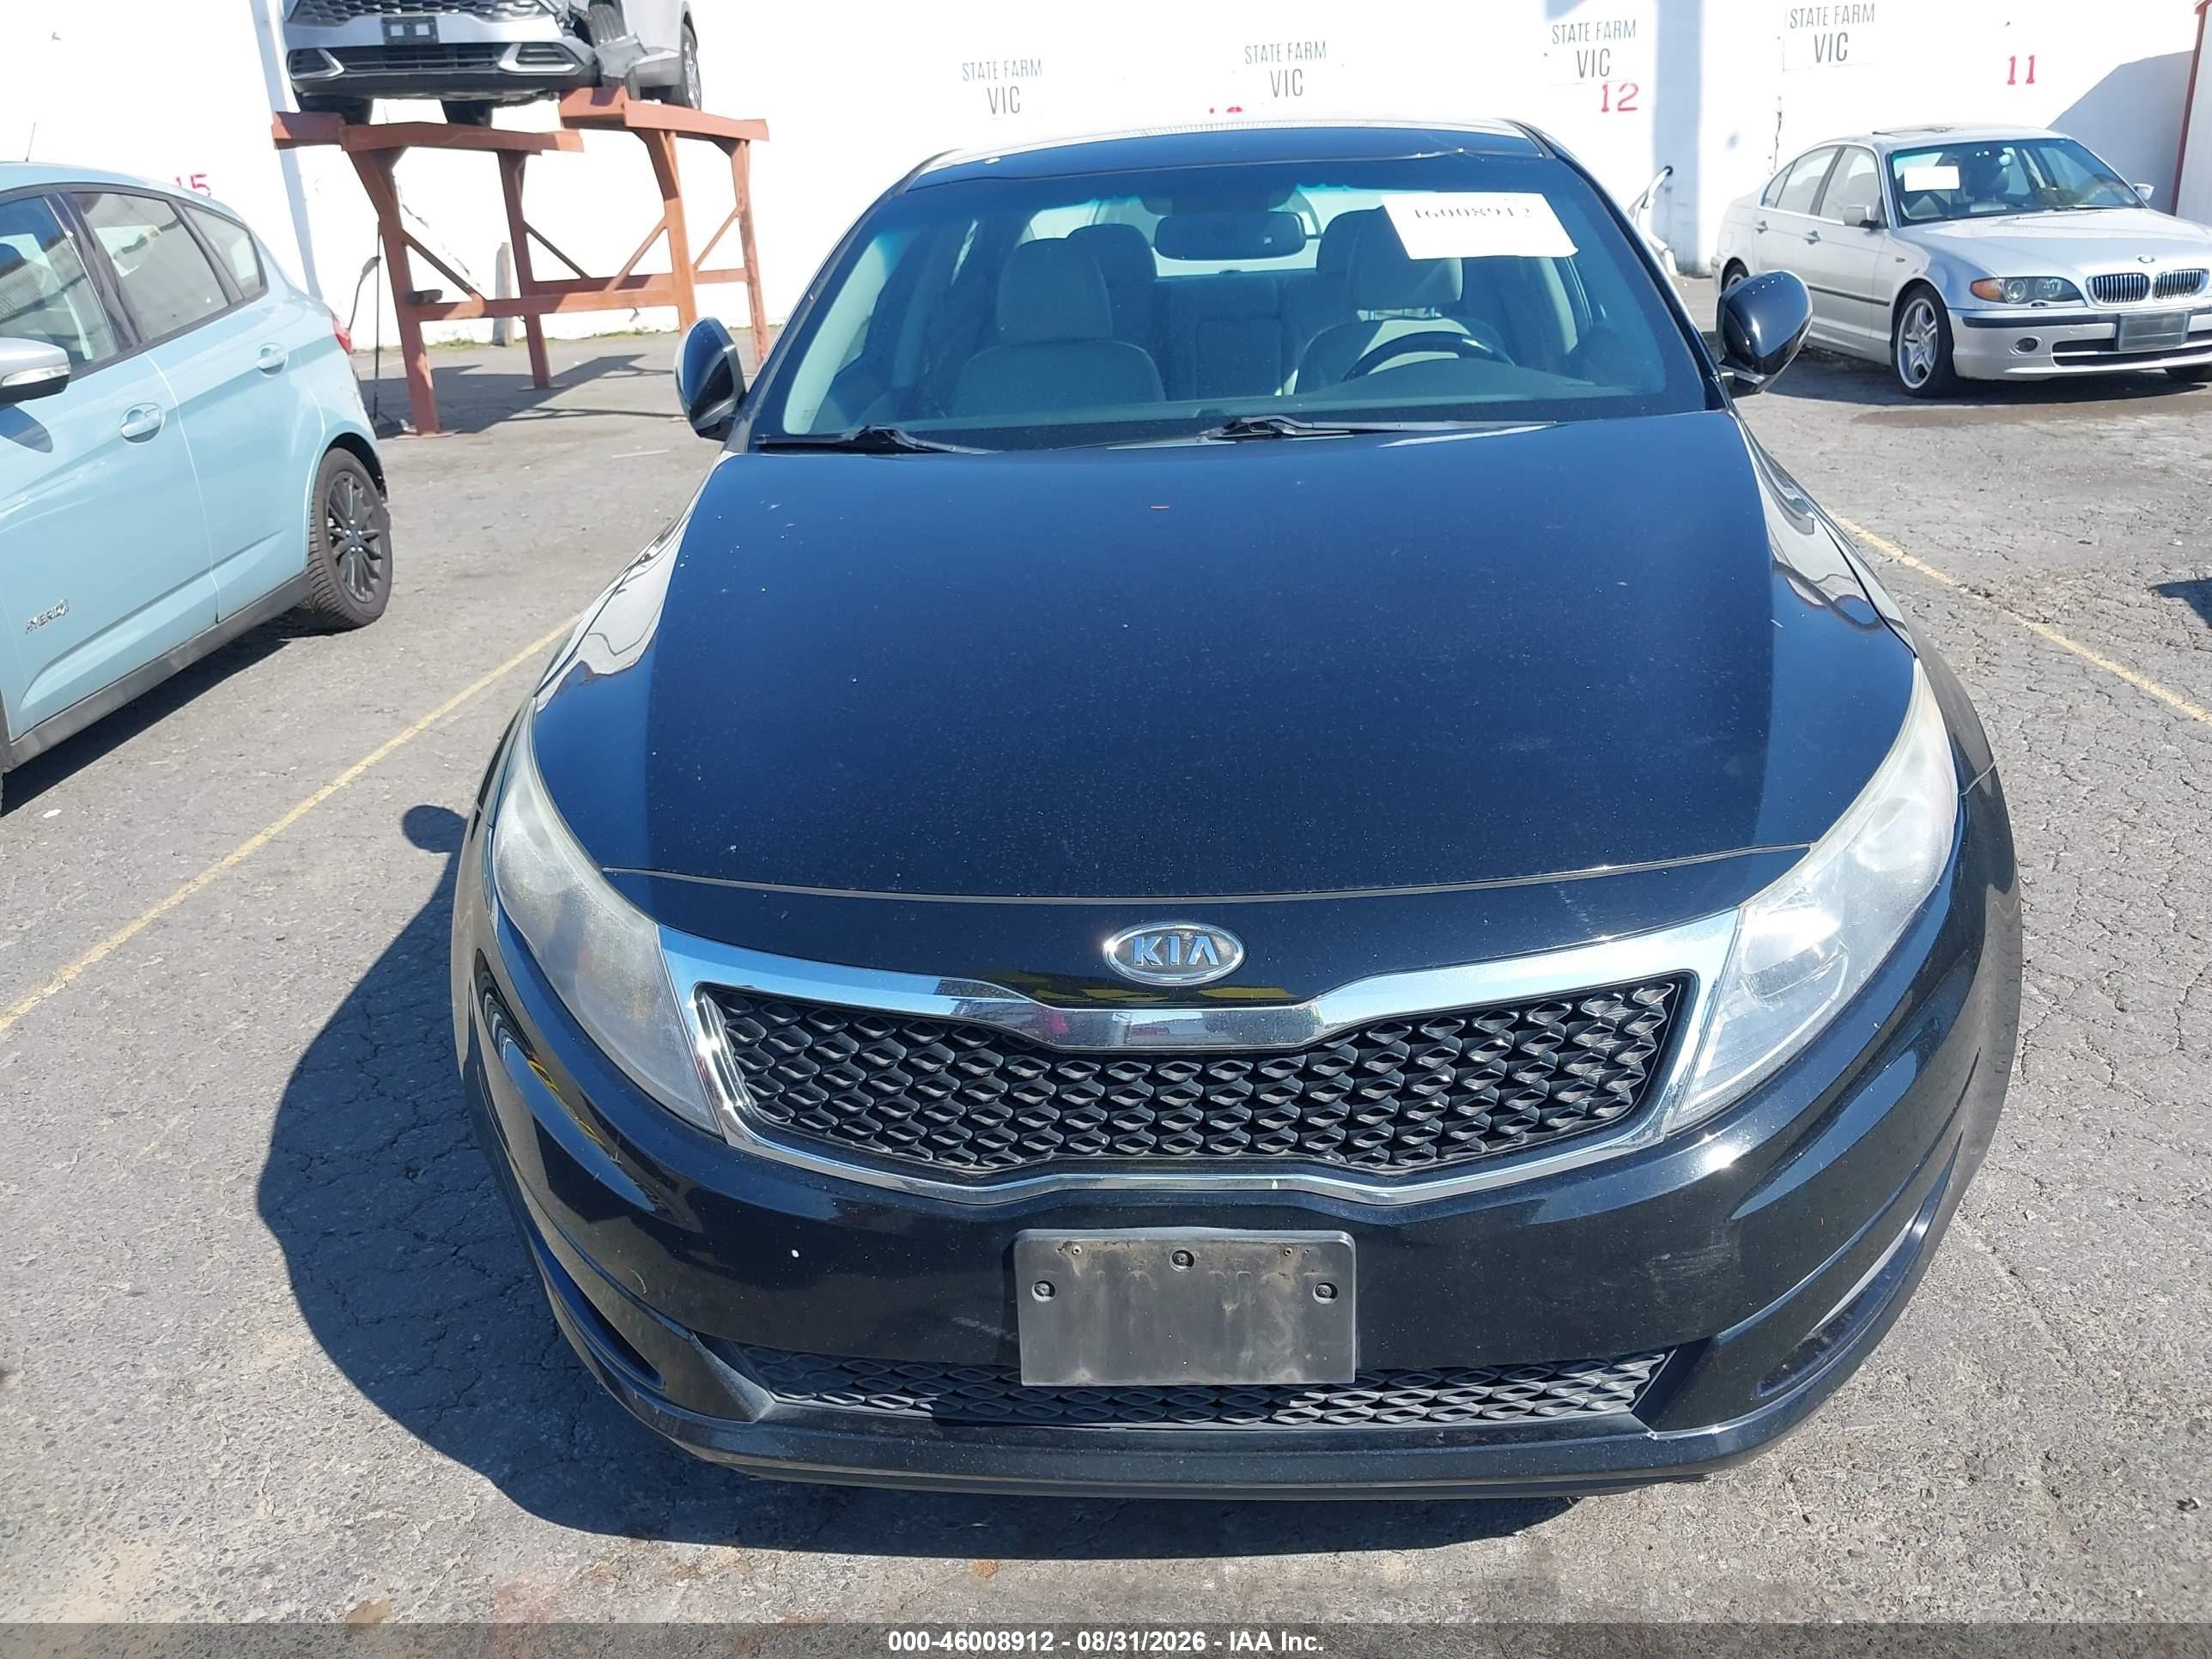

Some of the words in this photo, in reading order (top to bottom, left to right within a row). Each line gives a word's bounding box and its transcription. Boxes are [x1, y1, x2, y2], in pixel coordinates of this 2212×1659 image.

[1790, 7, 1829, 29] STATE
[1834, 3, 1875, 25] FARM
[1552, 22, 1590, 45] STATE
[1596, 19, 1636, 40] FARM
[1245, 44, 1282, 64] STATE
[1287, 40, 1327, 62] FARM
[1814, 32, 1848, 64] VIC
[962, 61, 999, 82] STATE
[1004, 58, 1042, 78] FARM
[1577, 48, 1610, 78] VIC
[2007, 55, 2034, 86] 11
[1270, 69, 1303, 98] VIC
[1601, 82, 1638, 112] 12
[987, 86, 1020, 115] VIC
[1133, 935, 1219, 966] KIA
